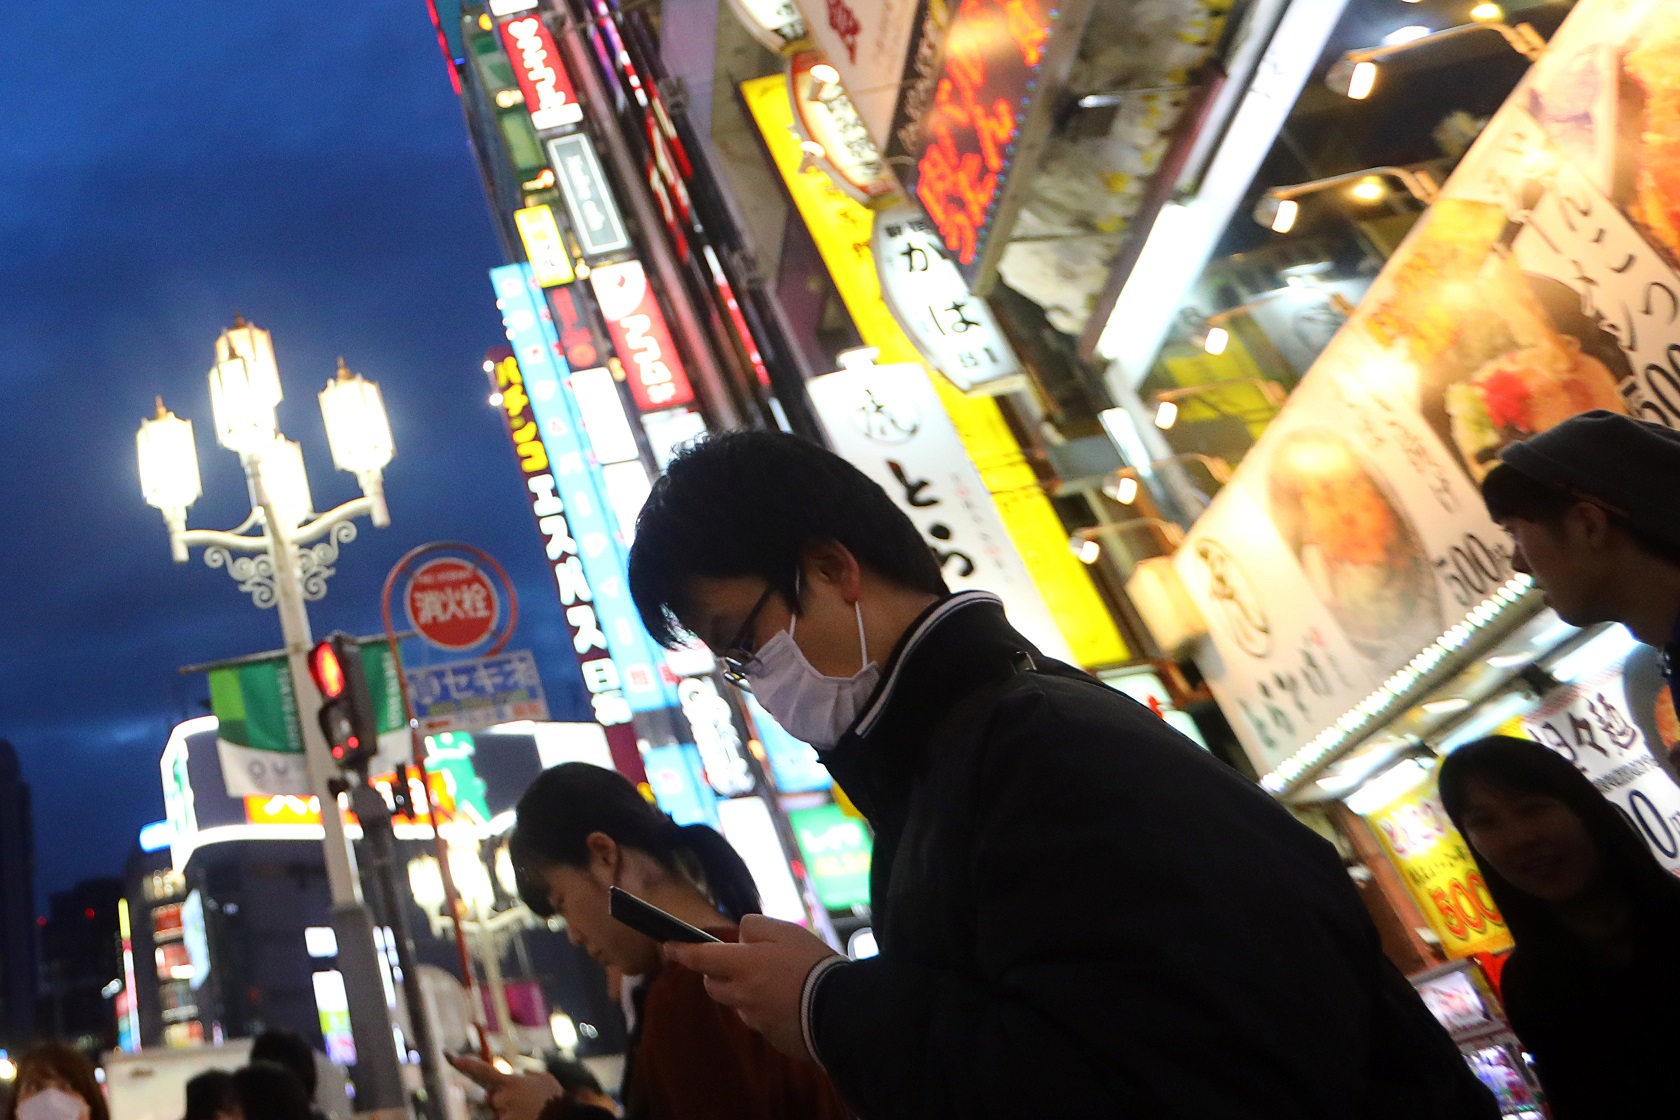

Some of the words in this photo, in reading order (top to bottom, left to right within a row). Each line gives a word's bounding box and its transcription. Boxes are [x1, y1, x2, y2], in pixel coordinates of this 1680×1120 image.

[495, 356, 550, 472] パチンコ
[412, 582, 491, 626] 消火栓
[1429, 872, 1505, 940] 500
